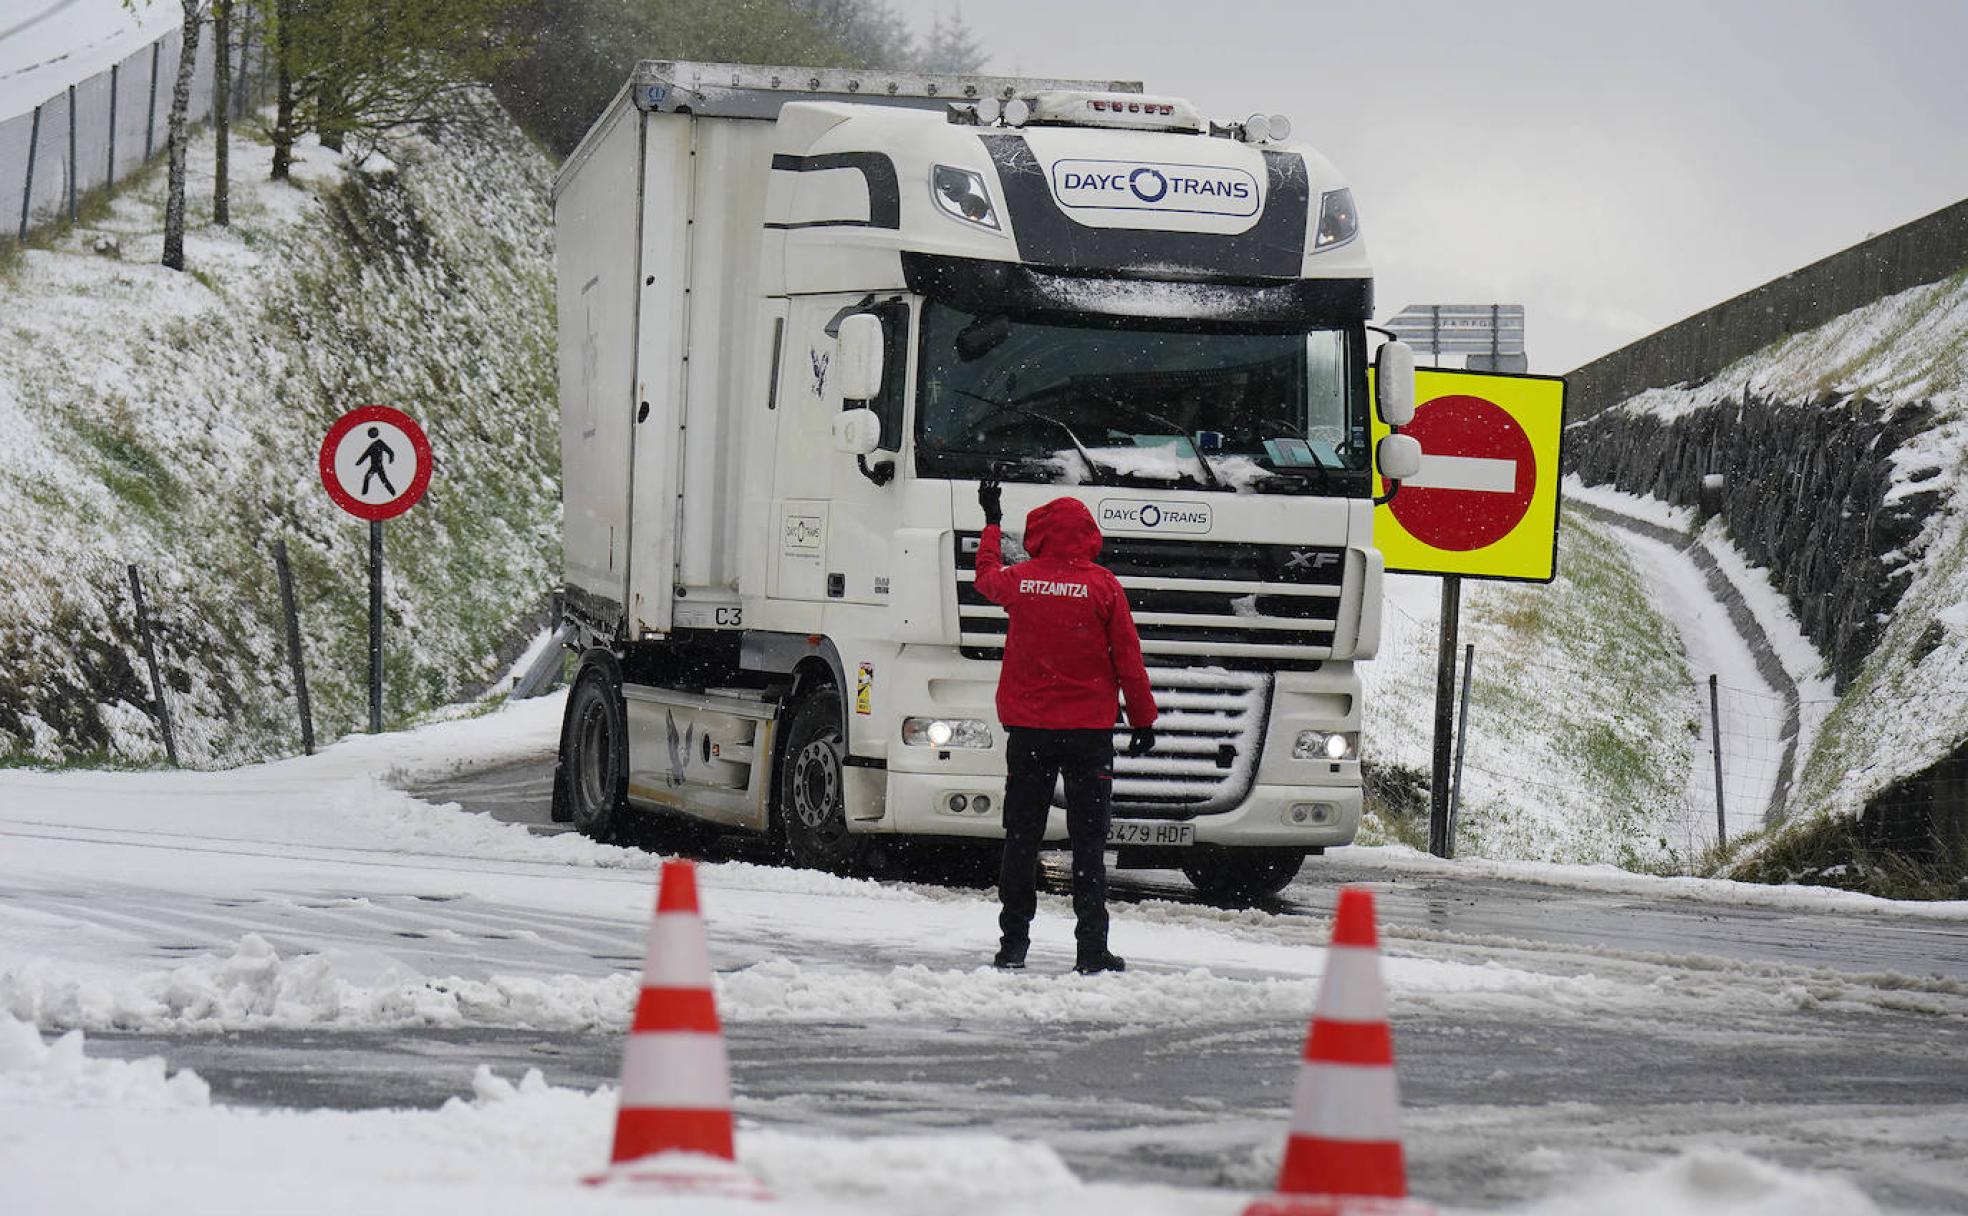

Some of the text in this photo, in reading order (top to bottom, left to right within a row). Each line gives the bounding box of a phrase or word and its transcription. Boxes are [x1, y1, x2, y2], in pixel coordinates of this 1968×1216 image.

[1284, 551, 1340, 568] XF
[1020, 579, 1088, 598] ERTZAINTZA
[716, 608, 742, 626] C3
[1157, 825, 1190, 843] HDF
